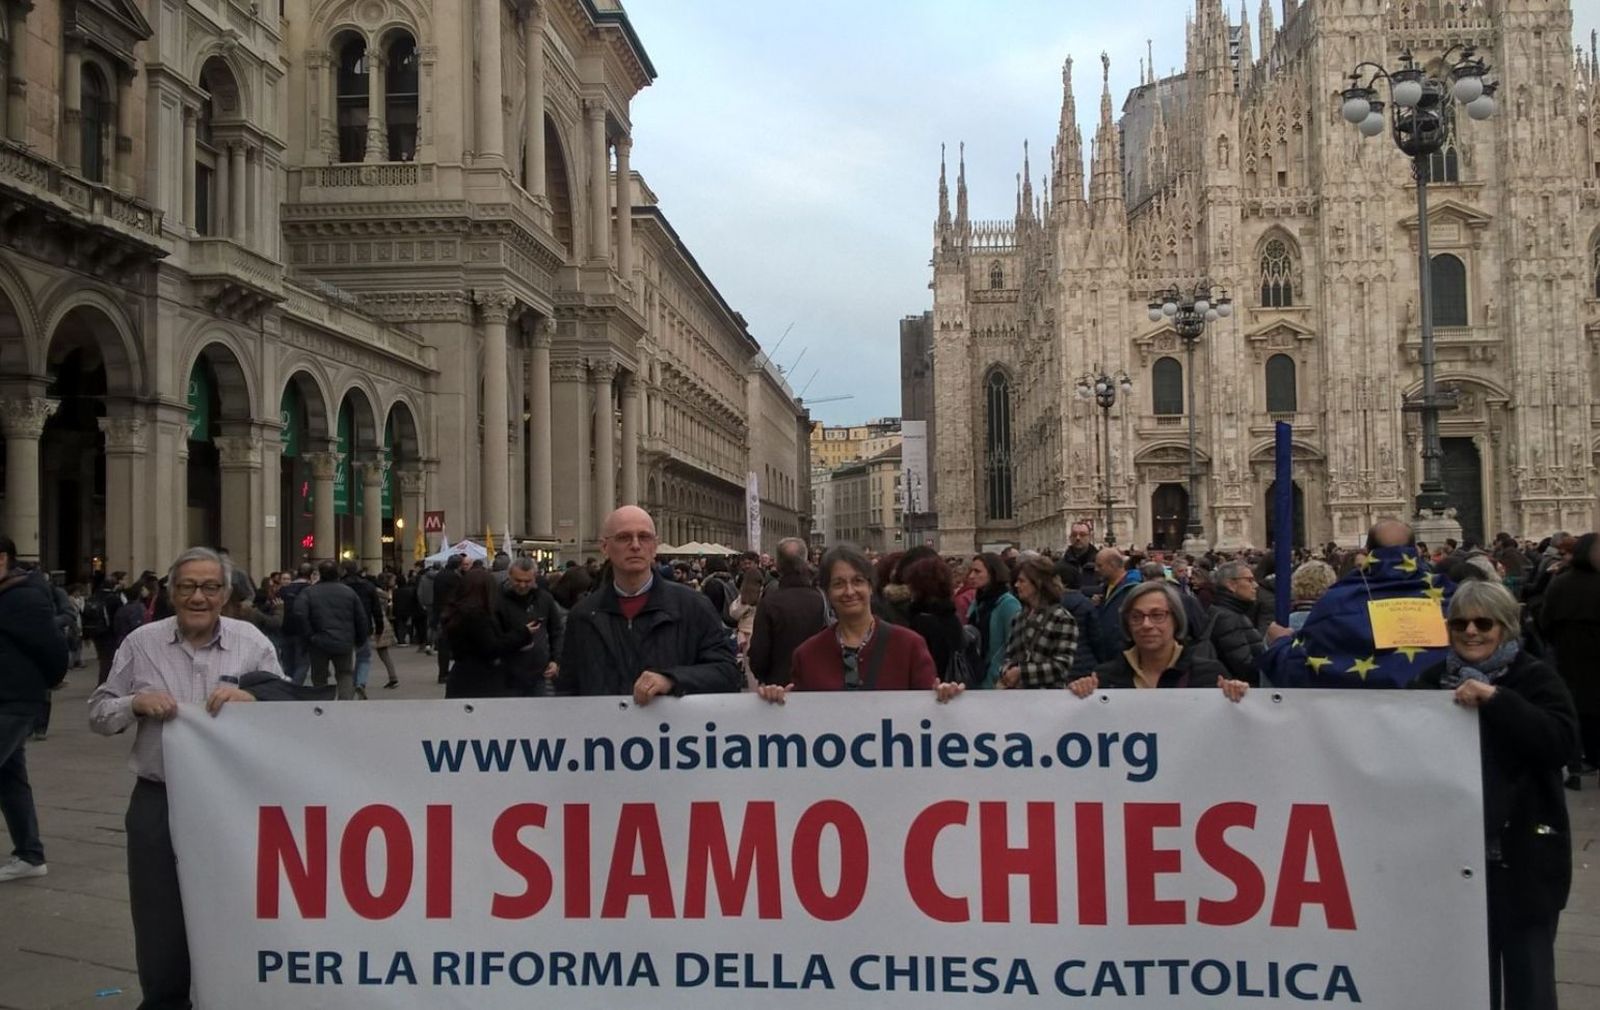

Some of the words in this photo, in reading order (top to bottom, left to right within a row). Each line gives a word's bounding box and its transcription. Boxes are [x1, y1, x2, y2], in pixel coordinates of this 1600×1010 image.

[426, 516, 442, 528] M
[421, 718, 1159, 783] www.noisiamochiesa.org
[257, 803, 453, 920] NOI
[491, 798, 869, 921] SIAMO
[903, 798, 1357, 930] CHIESA
[257, 950, 343, 985] PER
[358, 951, 418, 985] LA
[432, 951, 661, 987] RIFORMA
[675, 952, 837, 990] DELLA
[849, 954, 1040, 996] CHIESA
[1053, 958, 1363, 1005] CATTOLICA
